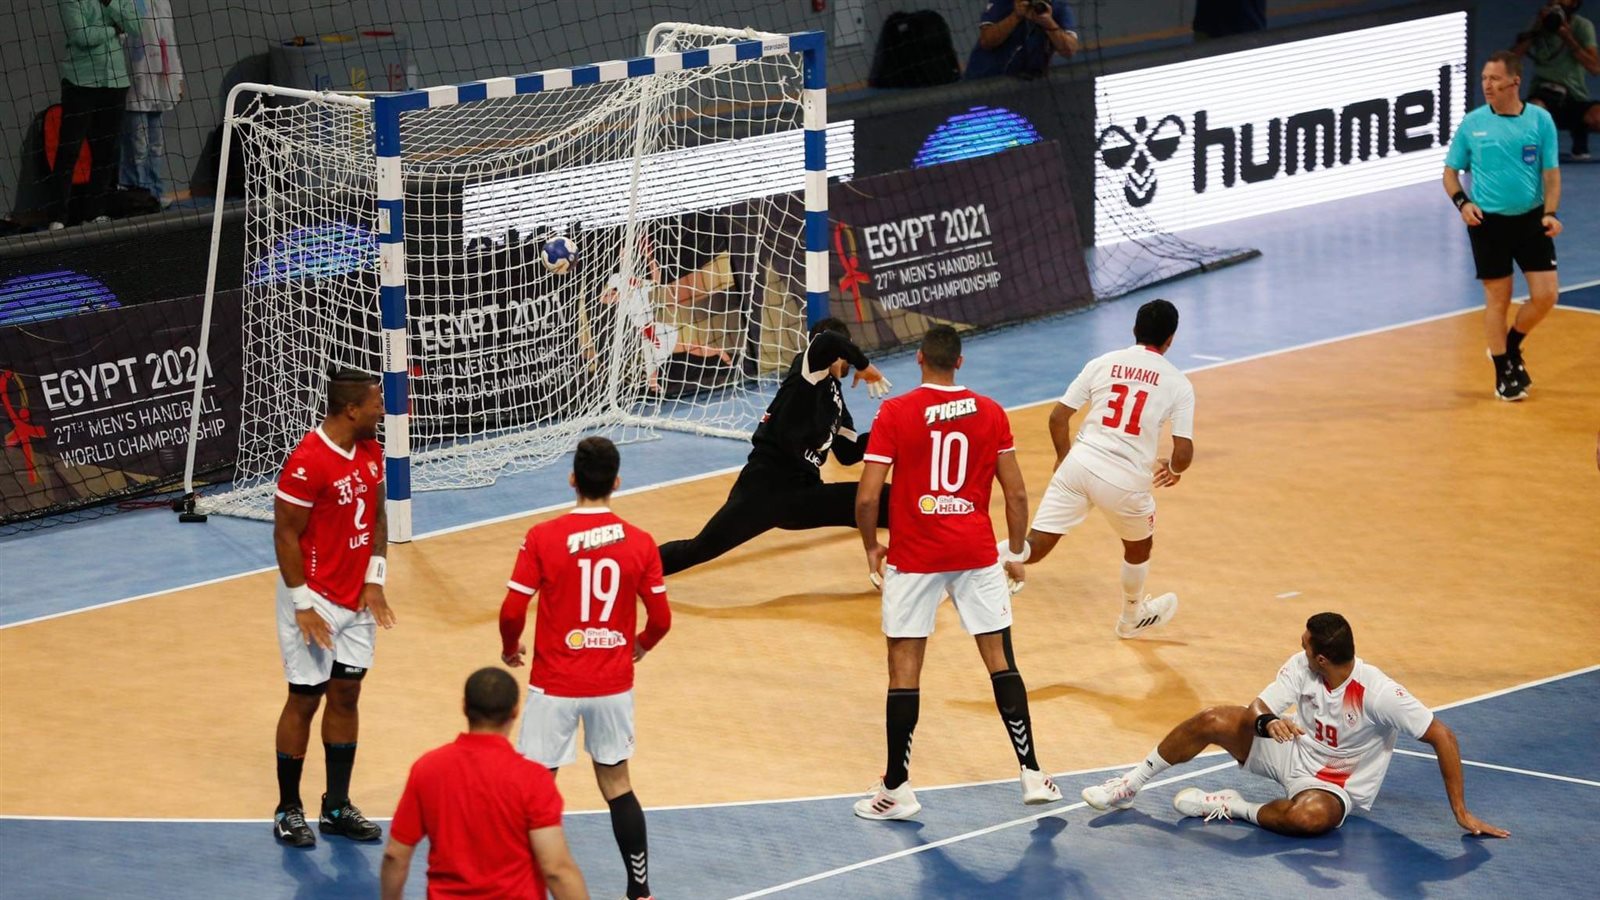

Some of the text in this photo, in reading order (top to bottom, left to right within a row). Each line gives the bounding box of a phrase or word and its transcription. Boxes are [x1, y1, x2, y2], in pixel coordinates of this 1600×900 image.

[1193, 64, 1451, 194] hummel
[864, 203, 991, 260] EGYPT 2021
[899, 263, 937, 285] MEN'S
[937, 250, 998, 278] HANDBALL
[880, 271, 1001, 311] WORLD CHAMPIONSHIP
[418, 292, 568, 351] EGYPT 2021
[39, 357, 138, 411] EGYPT
[1110, 364, 1160, 387] ELWAKIL
[53, 395, 222, 445] 27TH MEN'S HANDBLL
[925, 397, 978, 426] TIGER
[1102, 384, 1149, 436] 31
[59, 441, 116, 469] WORLD
[930, 430, 969, 493] 10
[338, 482, 353, 505] 33
[939, 502, 974, 512] HELIX
[567, 522, 625, 556] TIGER
[577, 557, 621, 623] 19
[1314, 719, 1339, 748] 39
